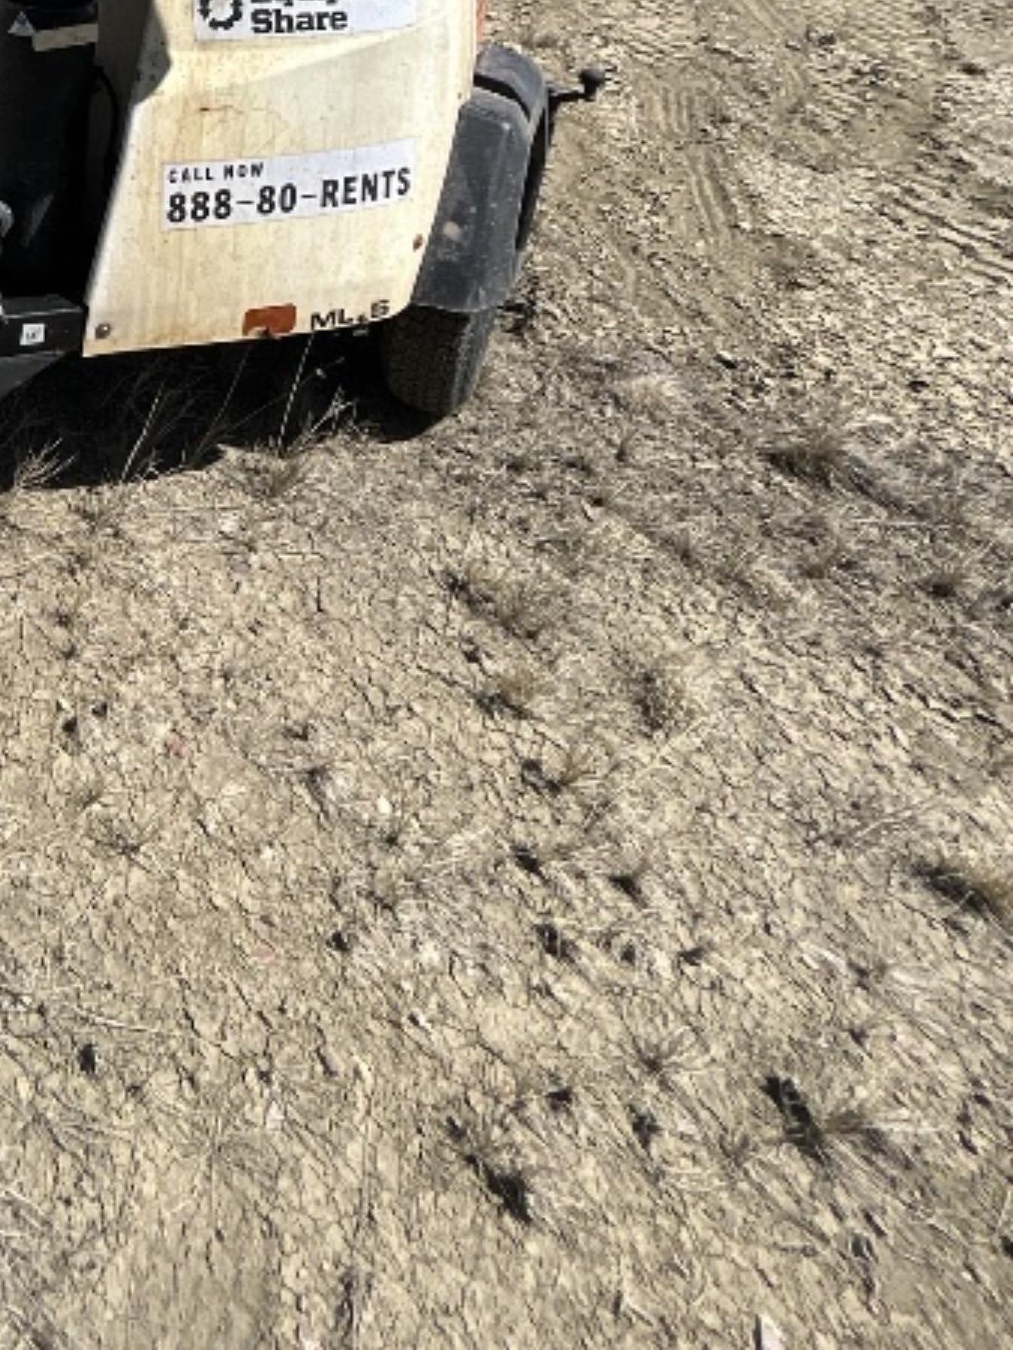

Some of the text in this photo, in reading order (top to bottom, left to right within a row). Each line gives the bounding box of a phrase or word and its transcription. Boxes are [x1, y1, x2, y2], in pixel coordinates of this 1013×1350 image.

[250, 8, 348, 35] Share
[167, 162, 264, 183] CALL NOW
[167, 168, 411, 223] 888-80-RENTS
